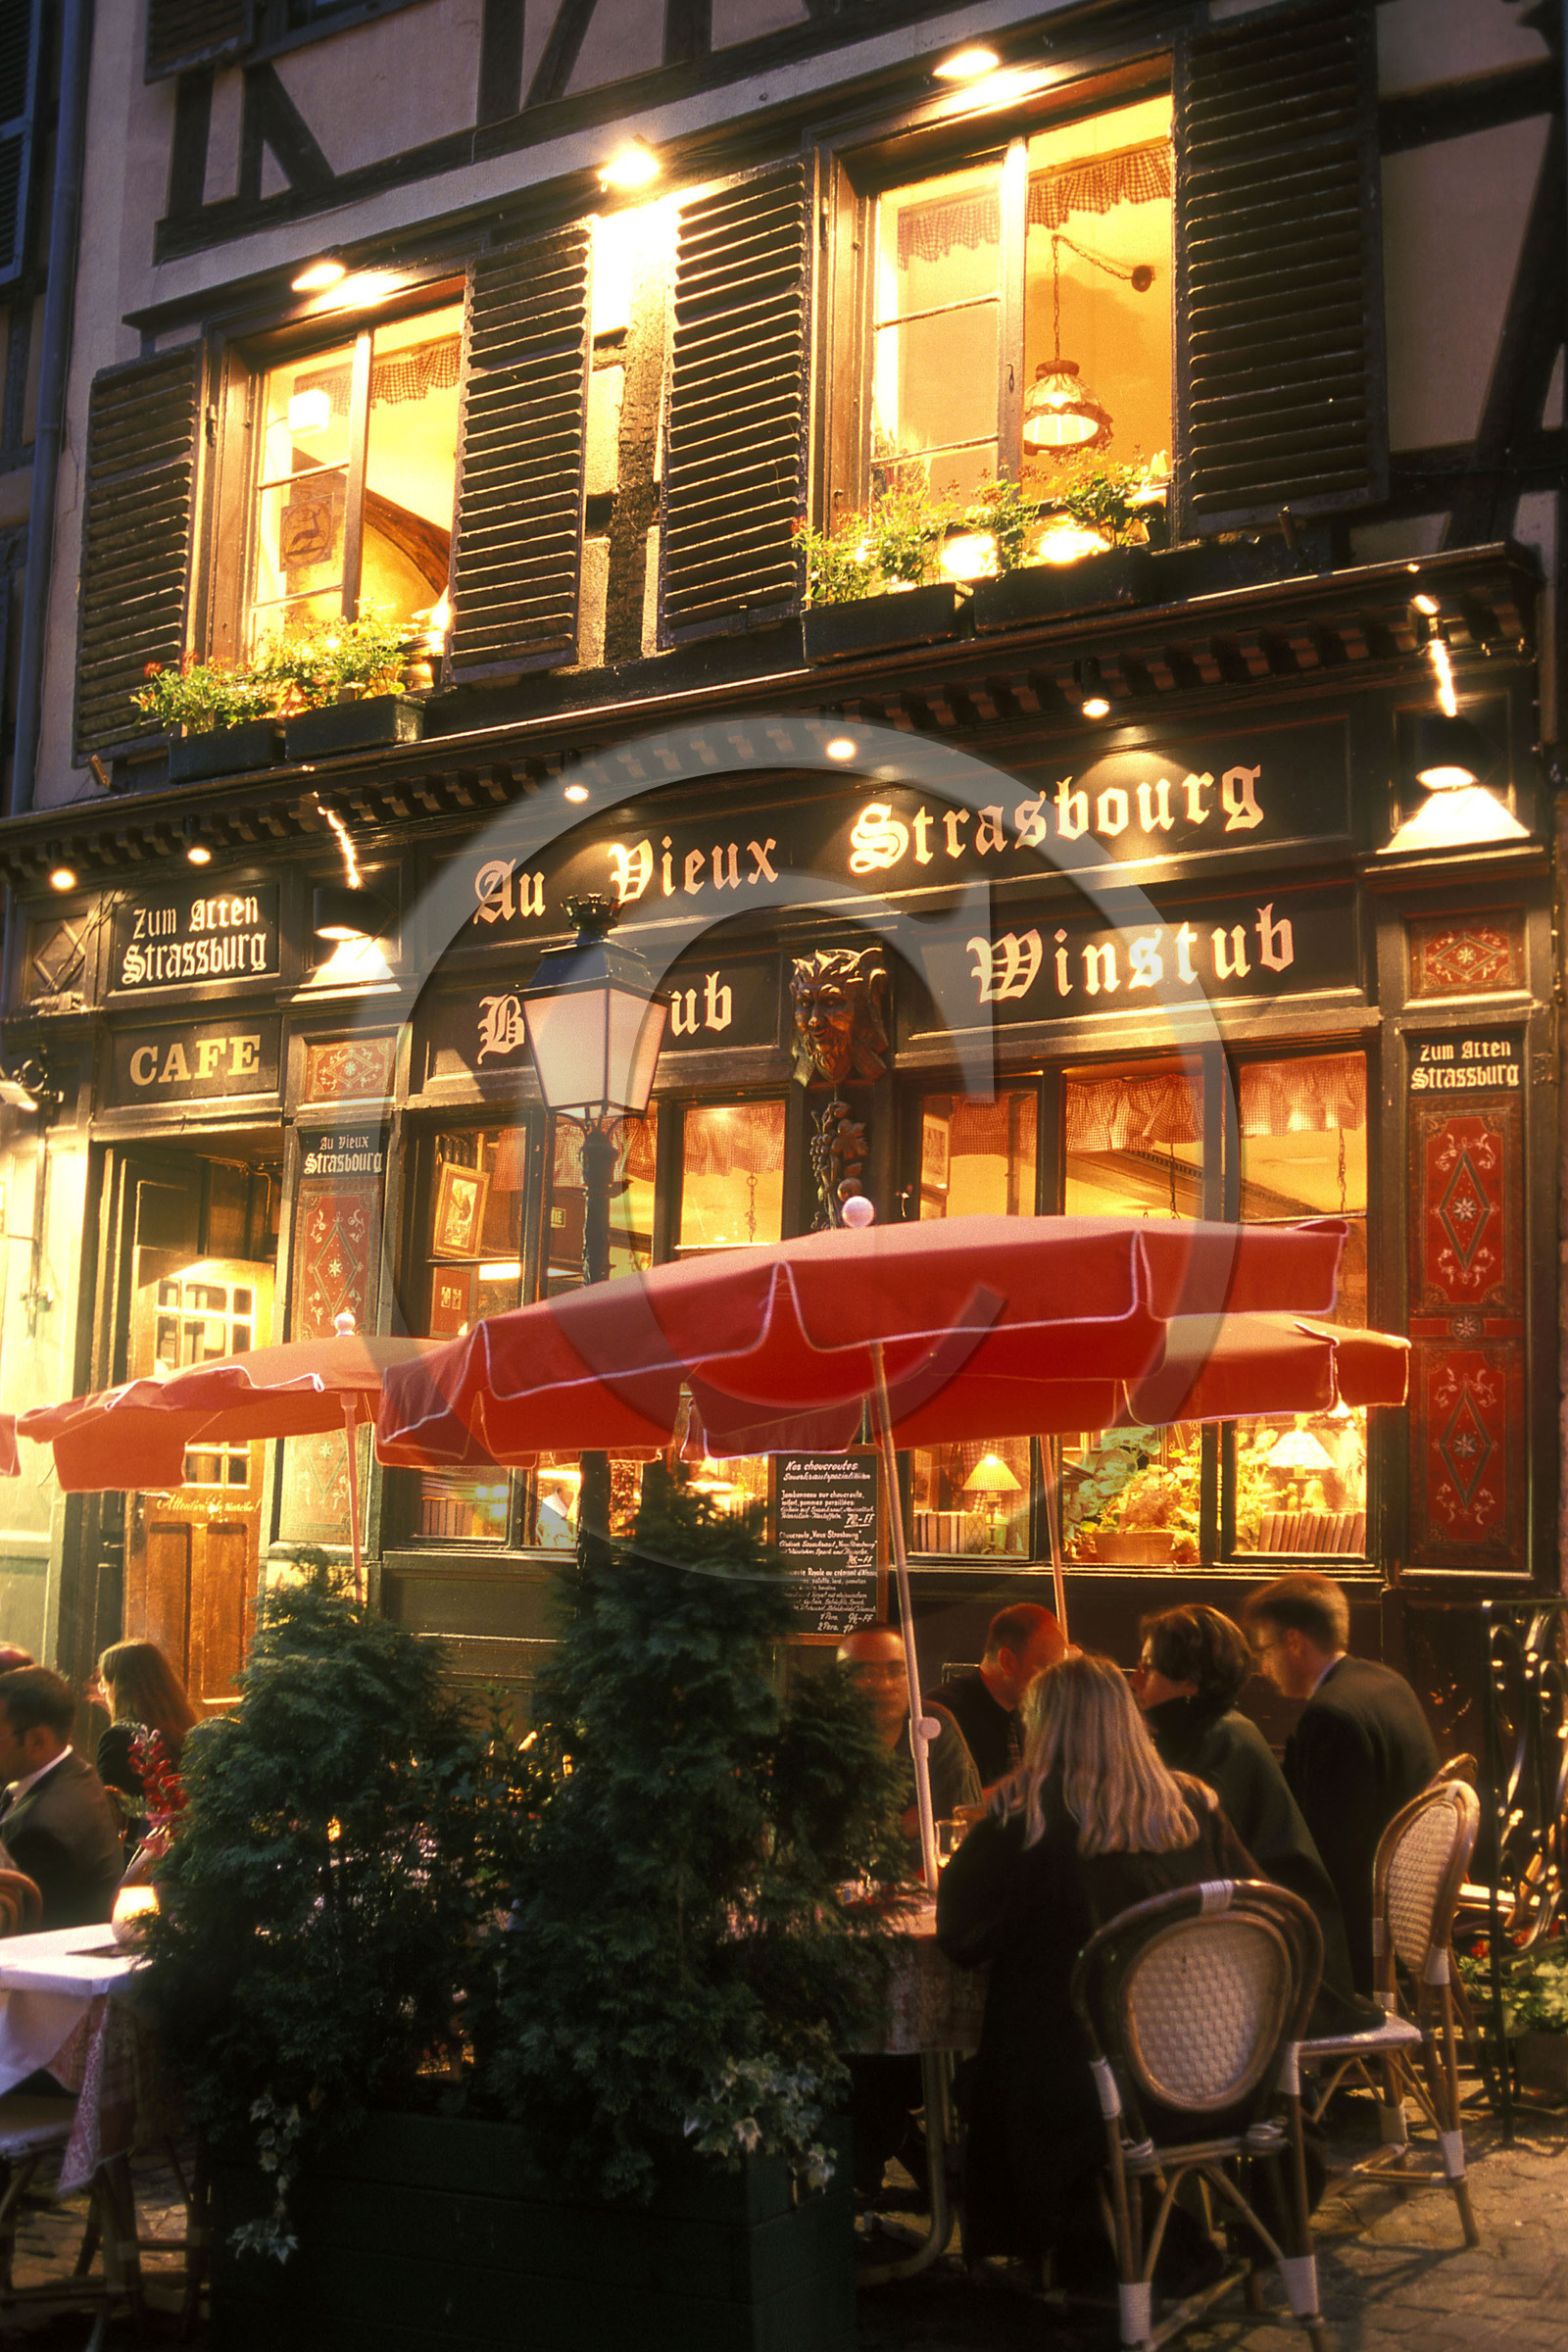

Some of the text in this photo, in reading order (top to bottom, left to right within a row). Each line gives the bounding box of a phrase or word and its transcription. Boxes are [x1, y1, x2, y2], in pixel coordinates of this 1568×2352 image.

[472, 763, 1264, 925] Au Vieux Strasbourg
[133, 894, 259, 940] Zum Alten
[122, 932, 267, 985] Strassburg
[965, 903, 1294, 1004] Winstub
[129, 1034, 261, 1087] CAFE
[1420, 1040, 1511, 1061] Zum Alten
[1410, 1063, 1519, 1090] Strassburg
[304, 1152, 382, 1175] Strasbourg
[319, 1134, 368, 1151] Au Vieux
